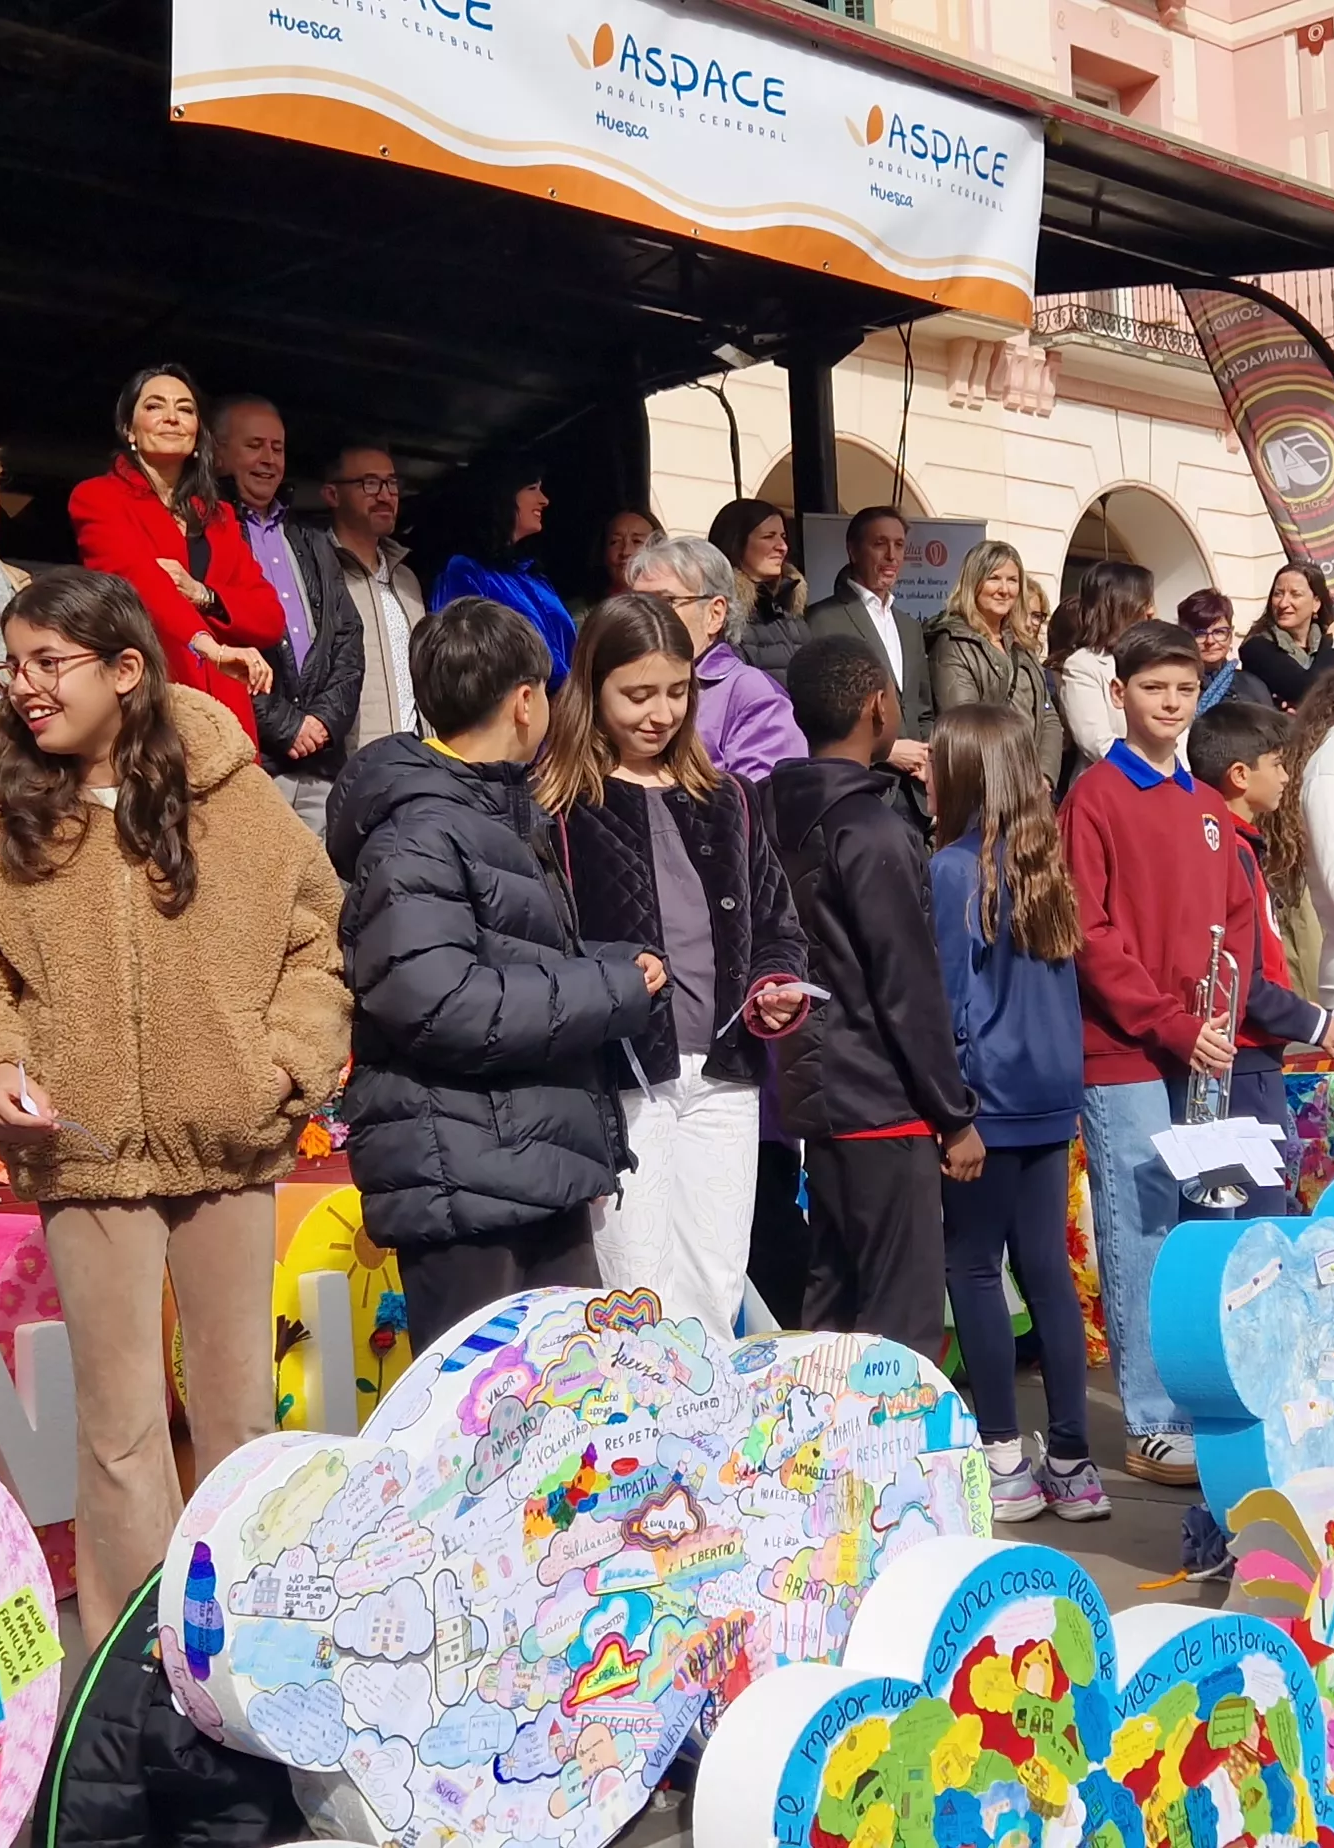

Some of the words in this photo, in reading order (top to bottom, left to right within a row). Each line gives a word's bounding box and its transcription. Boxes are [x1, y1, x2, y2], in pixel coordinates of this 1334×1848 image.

[267, 8, 344, 42] Huesca
[402, 17, 495, 61] CEREBRAL
[619, 33, 787, 116] ASPACE
[595, 81, 687, 119] PARÁLISIS
[698, 113, 787, 143] CEREBRAL
[595, 110, 650, 140] Huesca
[887, 113, 1009, 188] ASPACE
[868, 157, 943, 188] PARÁLISIS
[950, 183, 1005, 213] CEREBRAL
[869, 182, 914, 209] Huesca
[486, 1373, 517, 1406] VALOR
[863, 1359, 902, 1379] APOYO
[490, 1416, 538, 1461] AMISTAD
[604, 1427, 660, 1451] RESPETO
[608, 1468, 660, 1502] EMPATÍA
[678, 1541, 737, 1572] LIBERTAD
[15, 1612, 38, 1650] PARA
[31, 1650, 45, 1668] MI
[799, 1691, 873, 1765] mejor
[880, 1676, 935, 1711] lugar
[931, 1629, 957, 1674] es
[1000, 1568, 1057, 1596] casa
[1067, 1567, 1108, 1642] llena
[1173, 1635, 1203, 1675] de
[1210, 1617, 1288, 1664] historias
[647, 1694, 702, 1770] VALIENTES
